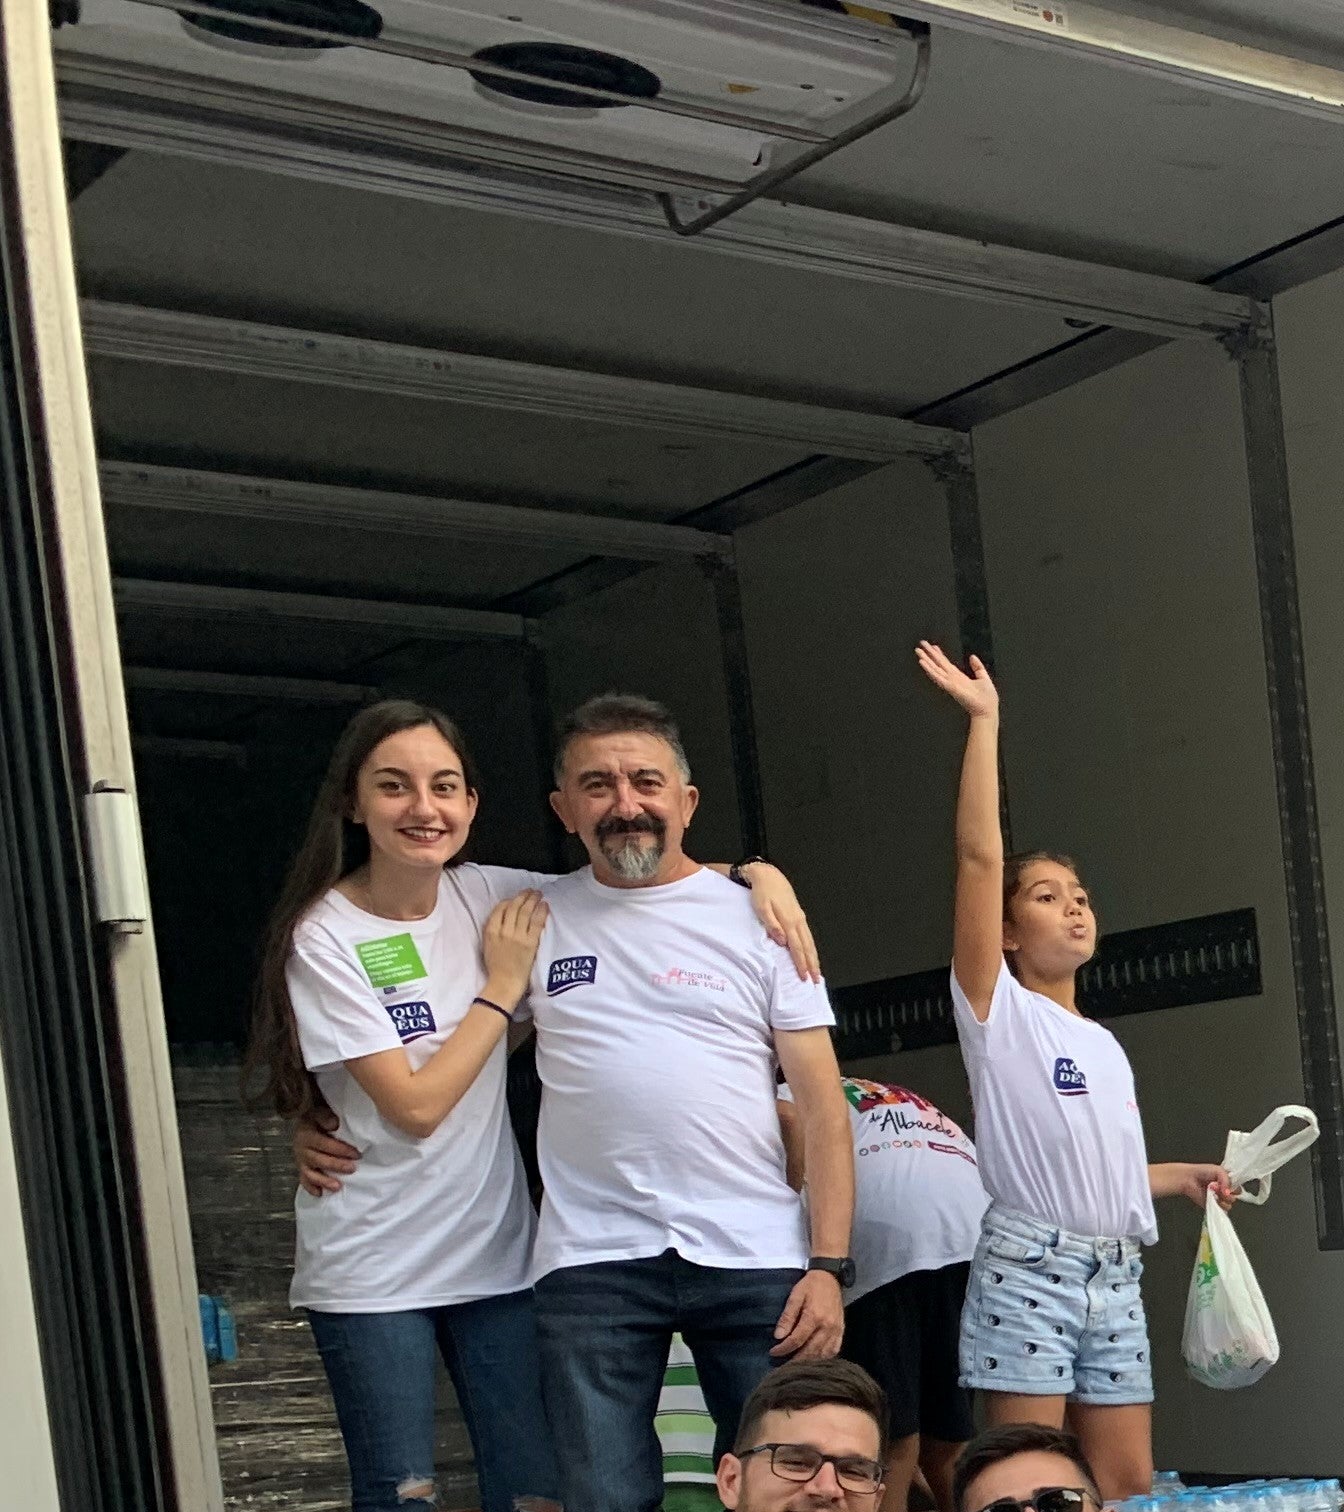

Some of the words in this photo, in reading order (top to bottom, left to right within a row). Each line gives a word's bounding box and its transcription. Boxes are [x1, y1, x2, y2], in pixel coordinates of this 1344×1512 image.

[552, 958, 592, 972] AQUA
[552, 969, 590, 983] DEUS
[391, 1005, 429, 1020] QUA
[397, 1017, 431, 1031] EUS
